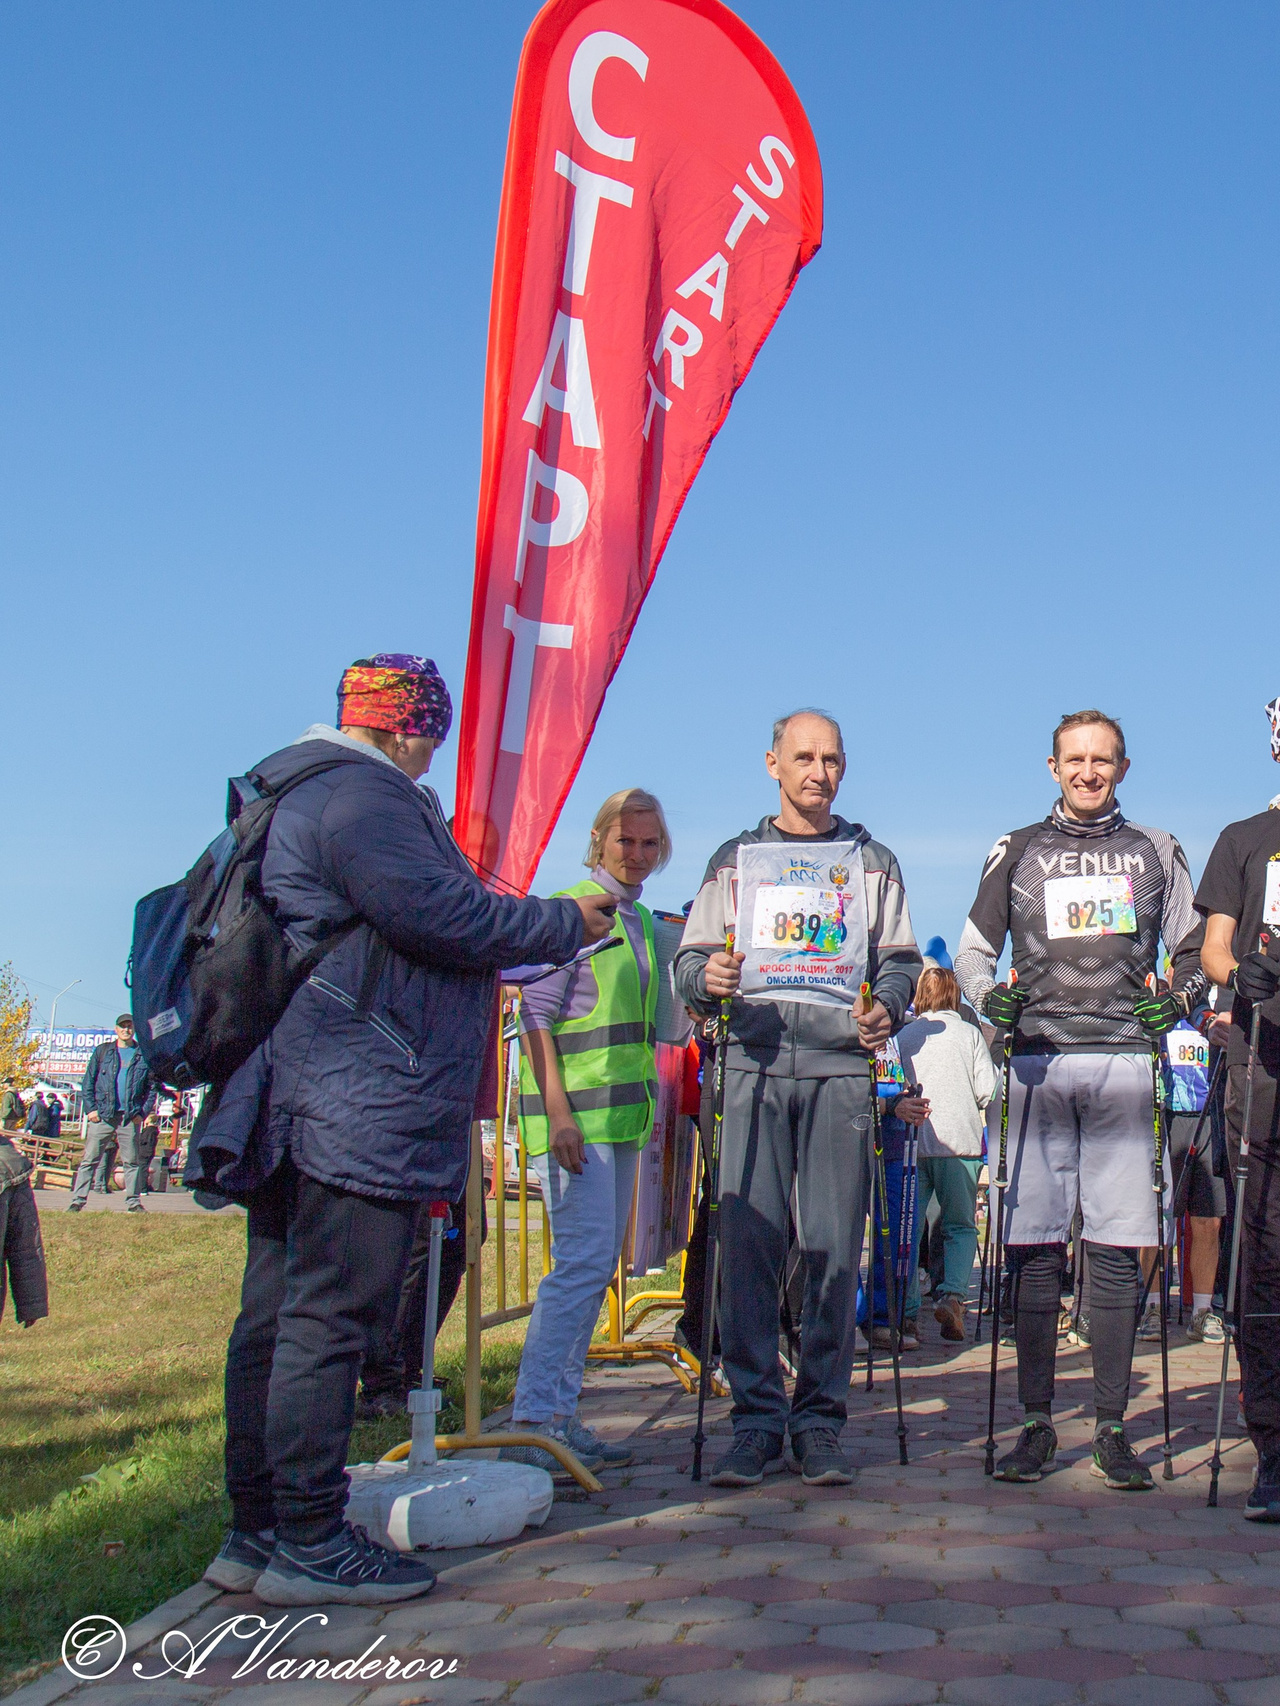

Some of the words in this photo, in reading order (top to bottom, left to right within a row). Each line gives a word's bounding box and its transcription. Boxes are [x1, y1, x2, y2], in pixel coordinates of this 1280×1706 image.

[641, 133, 796, 442] START
[499, 30, 649, 756] СТАРТ
[1038, 851, 1145, 876] VENUM
[1067, 899, 1114, 930] 825
[773, 911, 821, 943] 839
[759, 963, 792, 974] КРОСС
[794, 964, 828, 975] НАЦИИ
[834, 965, 854, 975] 2017
[766, 975, 806, 986] ОМСКАЯ
[807, 976, 847, 986] ОБЛАСТЬ
[31, 1032, 74, 1048] ГОРОД
[1178, 1044, 1205, 1062] 830
[875, 1059, 896, 1078] 802
